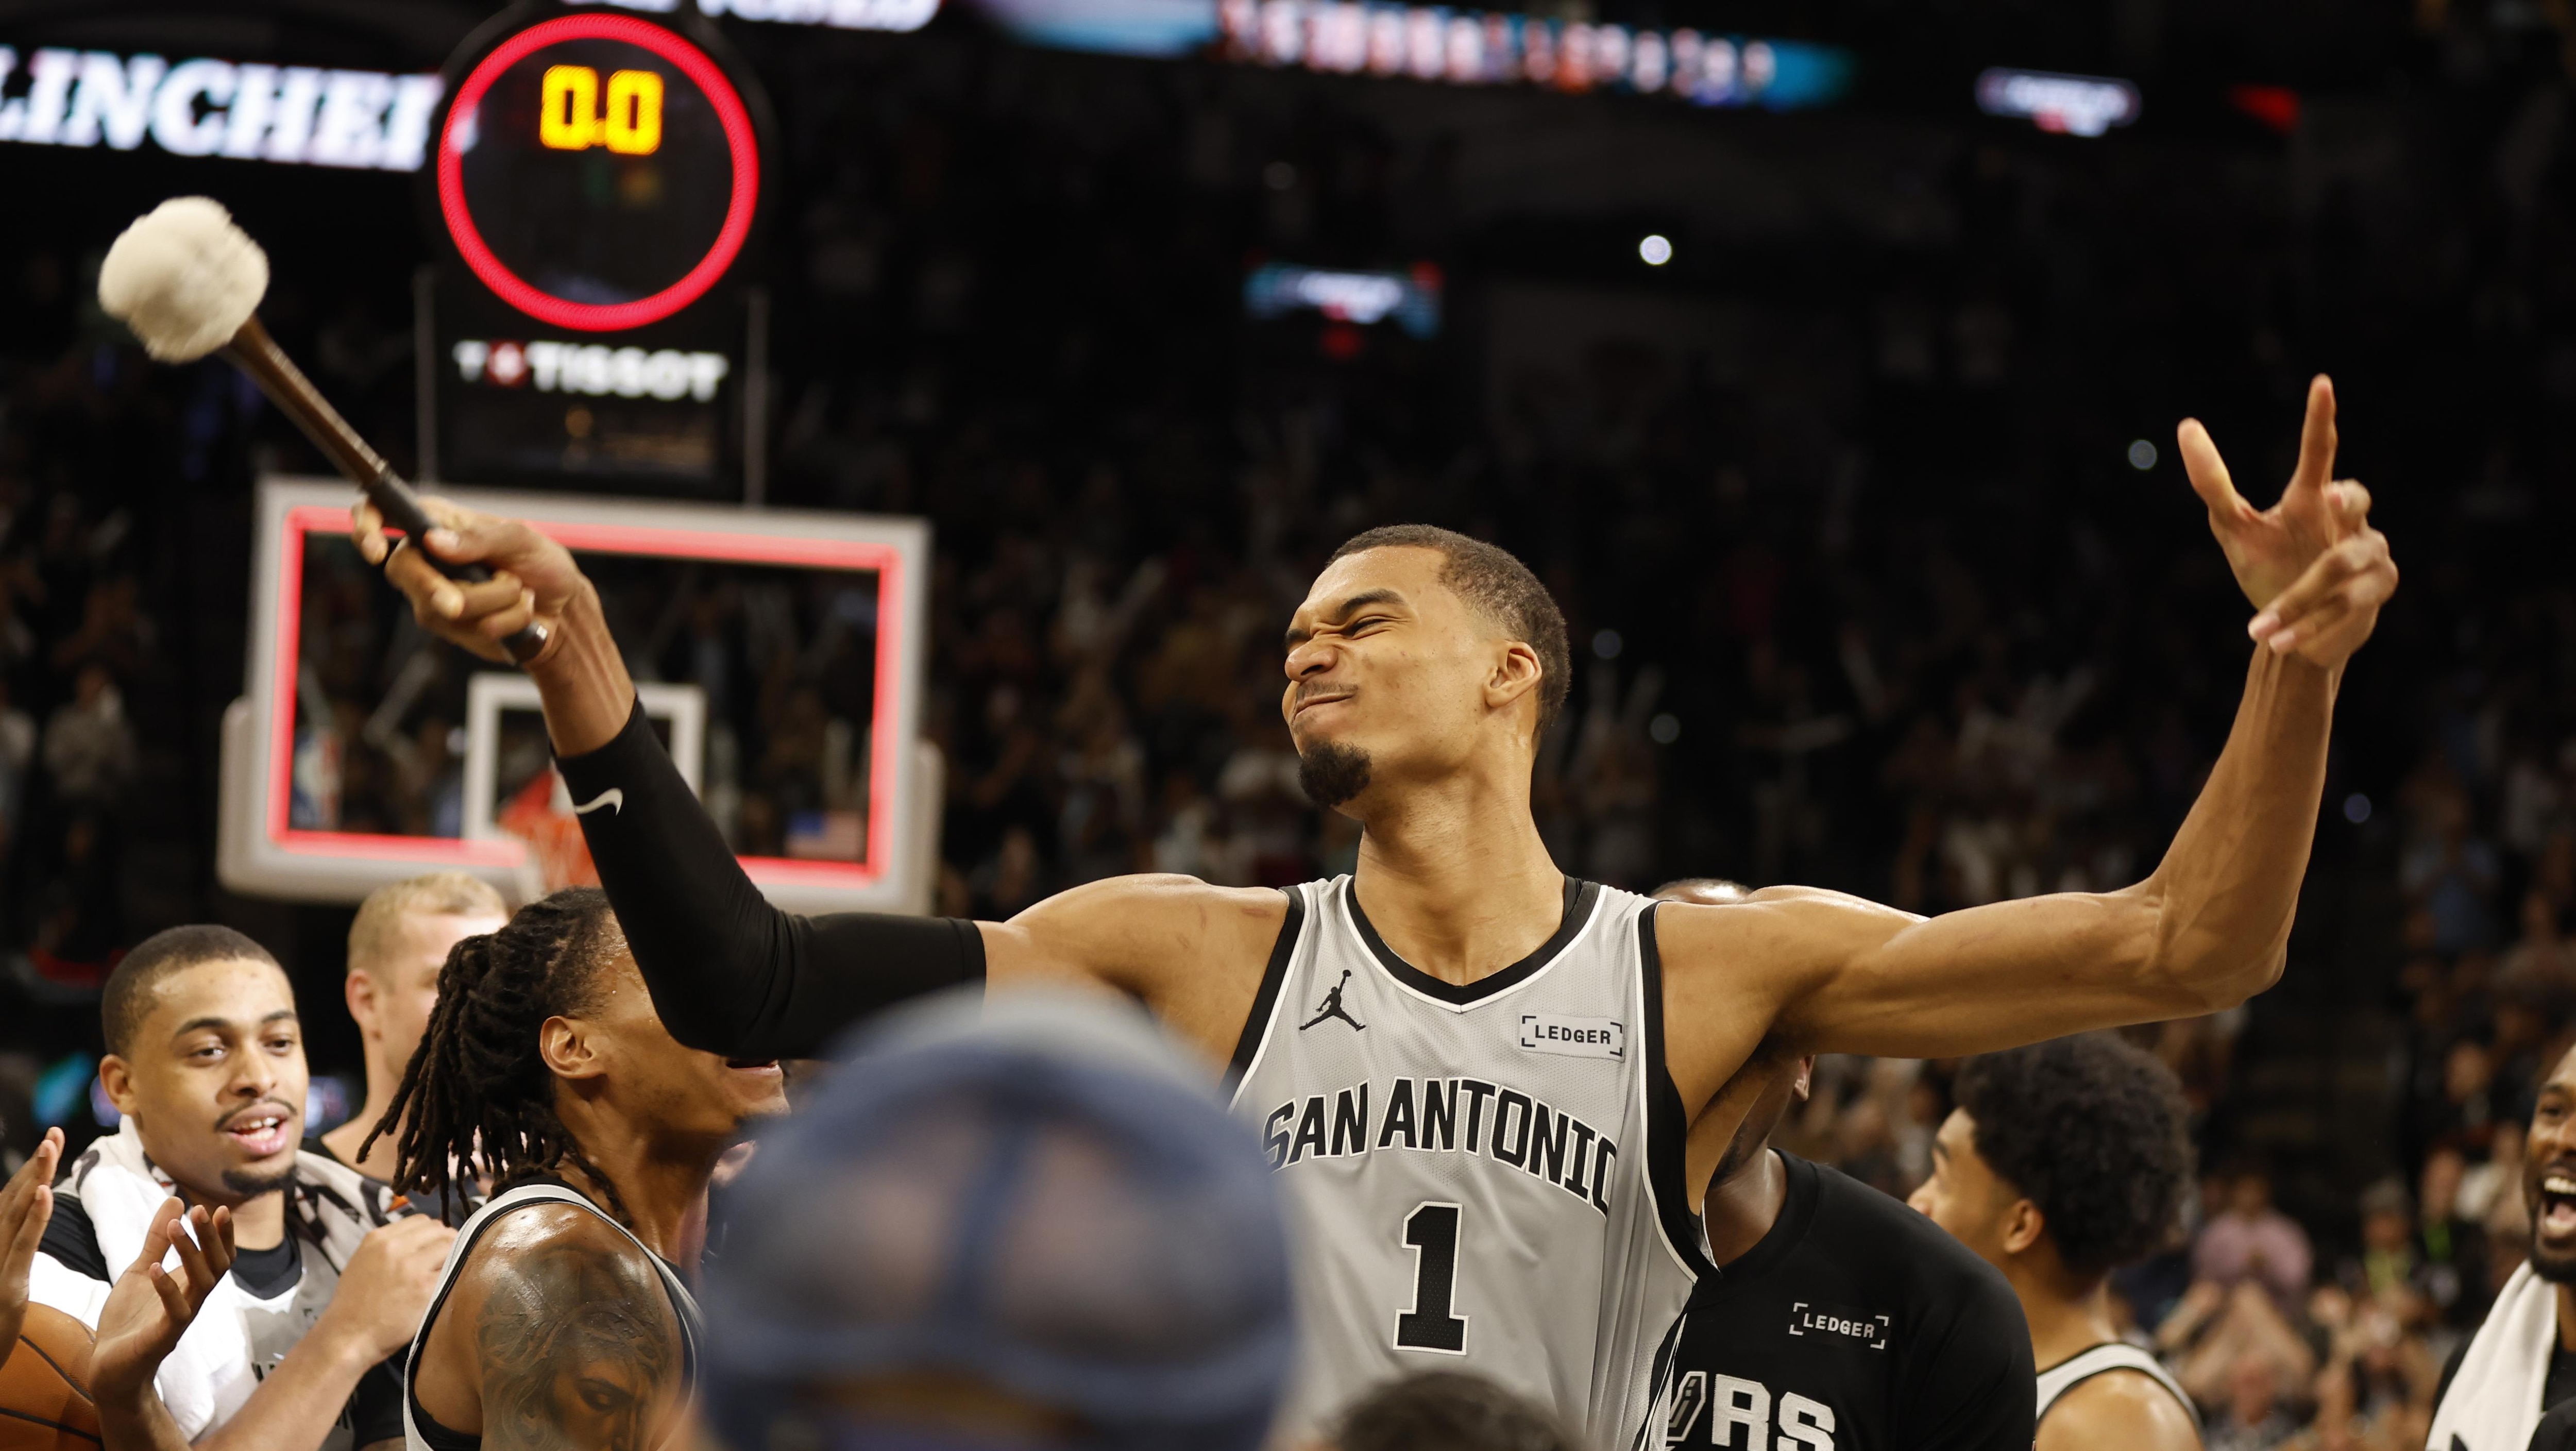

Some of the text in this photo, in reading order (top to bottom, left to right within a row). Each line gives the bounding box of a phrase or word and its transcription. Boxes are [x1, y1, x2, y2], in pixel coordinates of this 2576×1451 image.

[526, 340, 730, 403] TISSOT
[1535, 1024, 1611, 1044] LEDGER
[1262, 1077, 1370, 1174] SAN
[1393, 1201, 1469, 1356] 1
[1803, 1313, 1875, 1339] LEDGER
